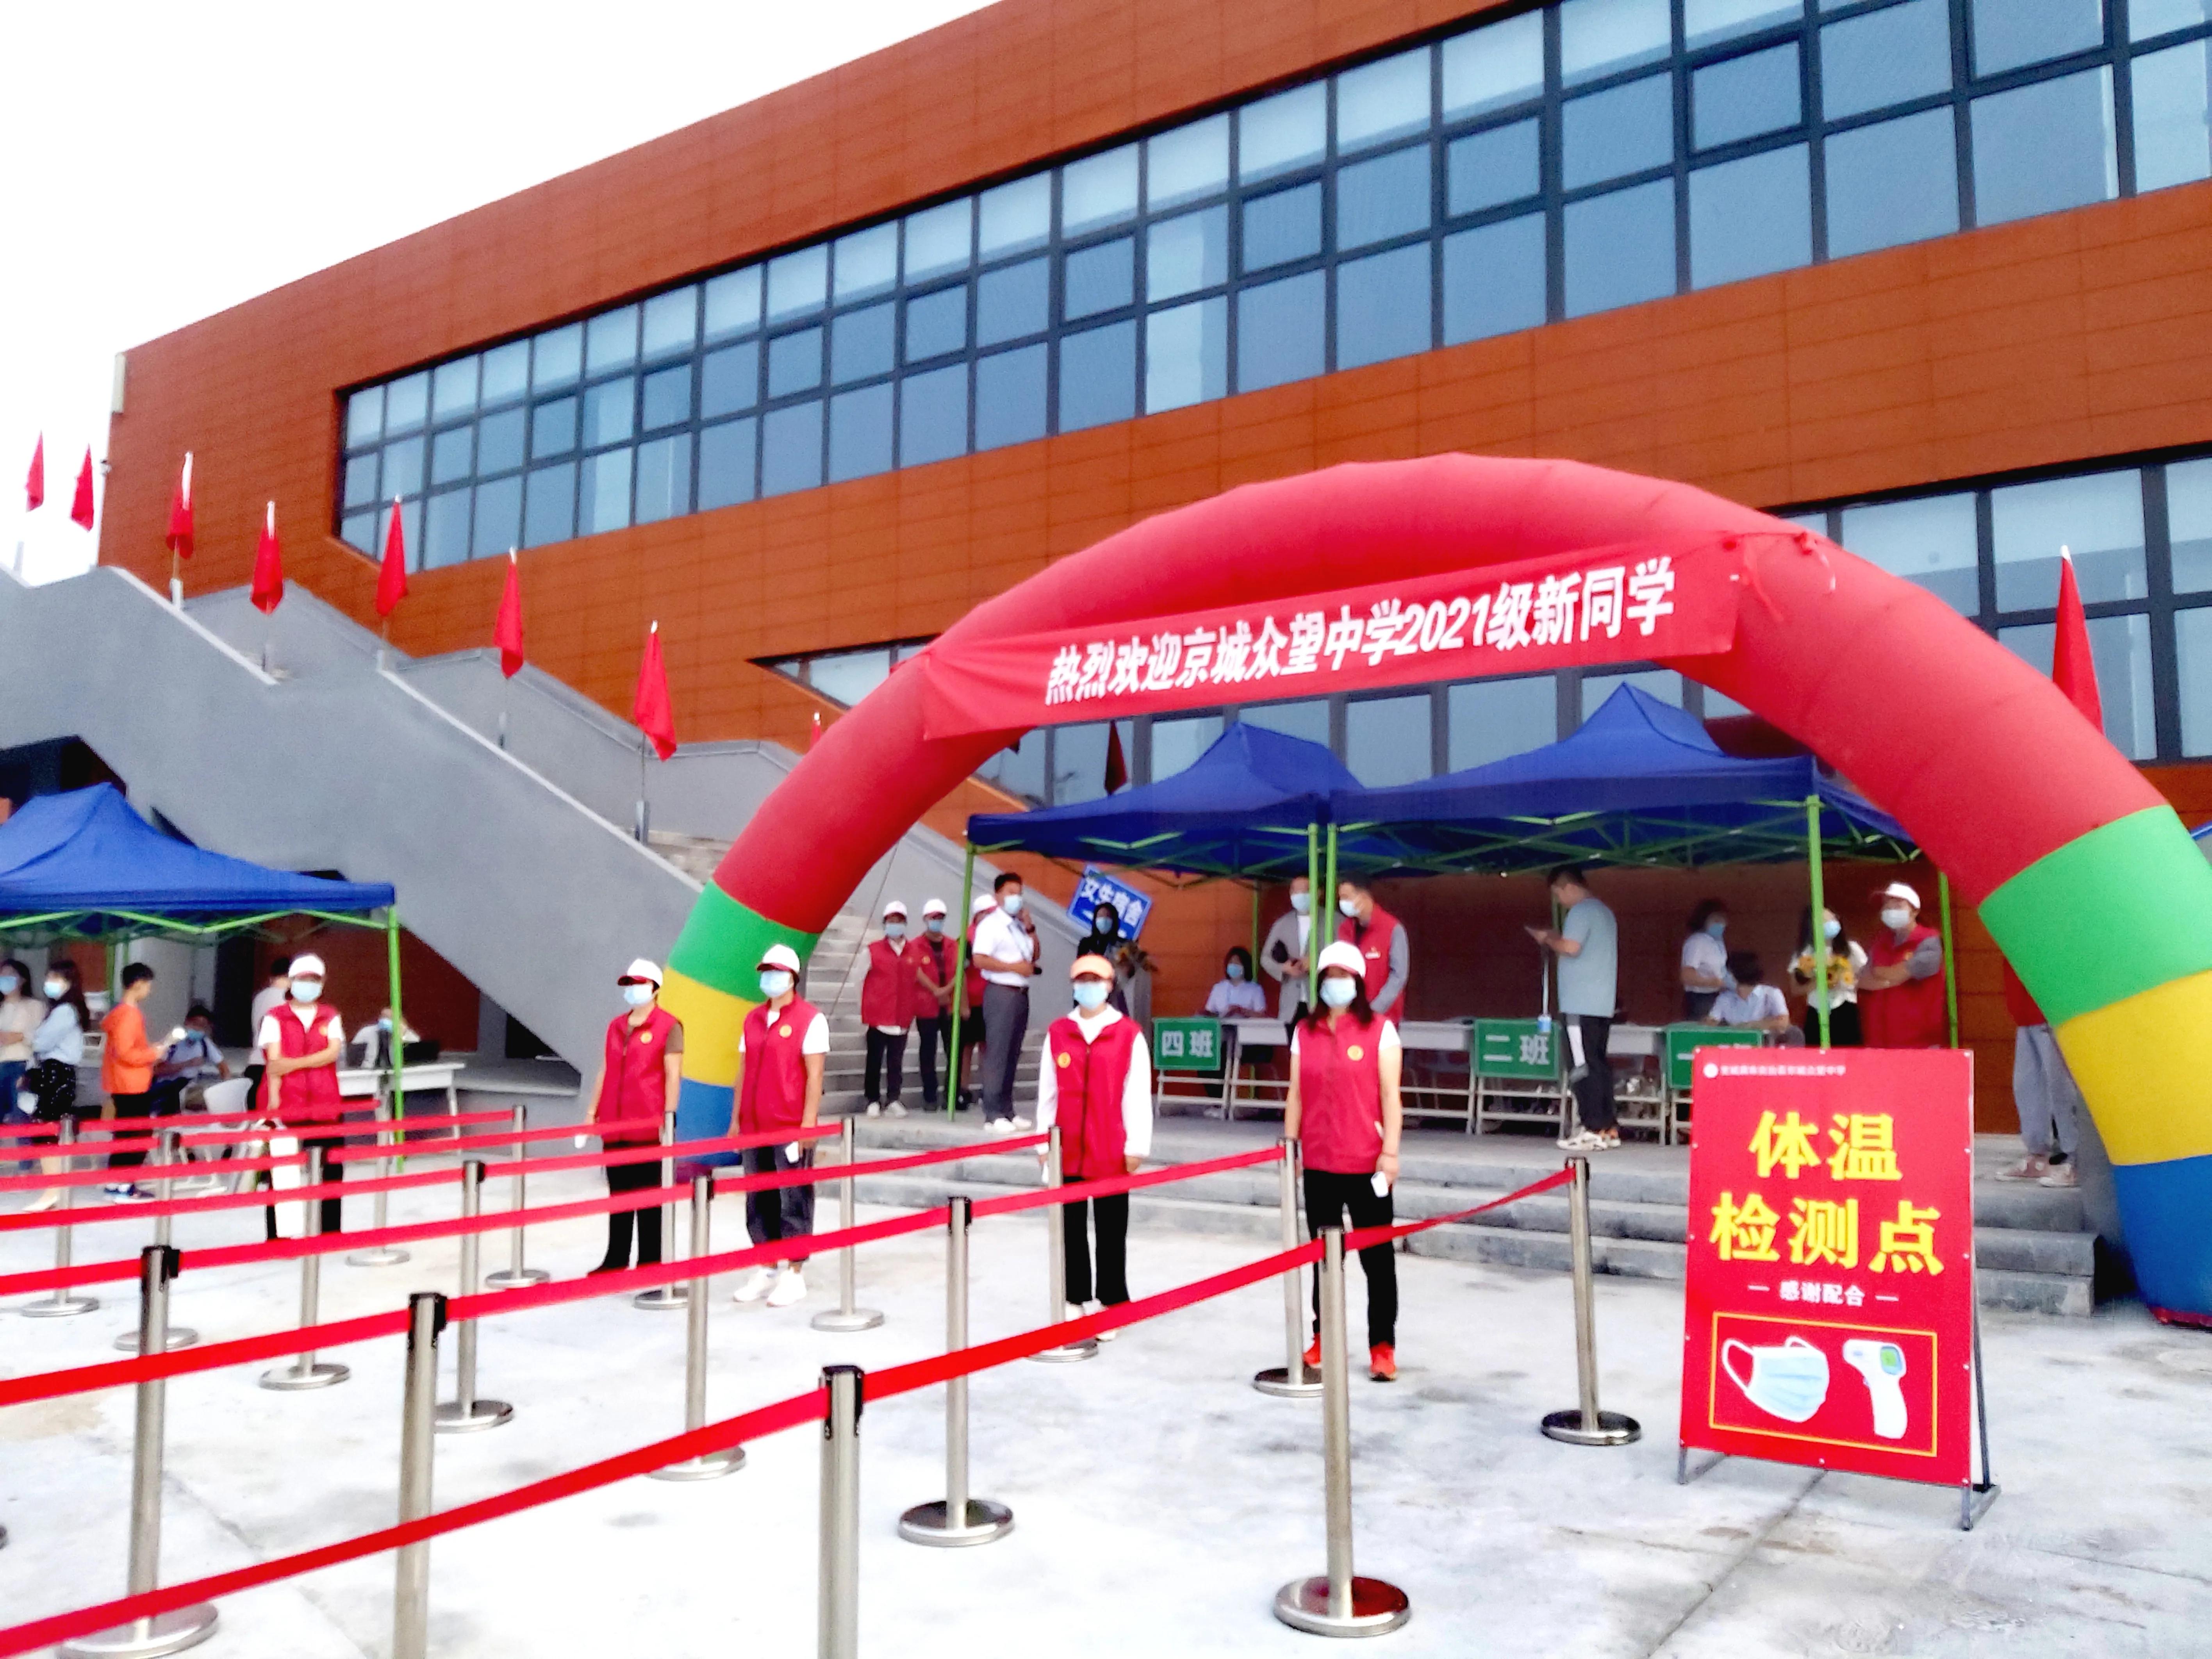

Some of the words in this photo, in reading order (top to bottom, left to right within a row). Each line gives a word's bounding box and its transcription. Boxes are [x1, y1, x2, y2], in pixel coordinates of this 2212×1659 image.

[1045, 556, 1675, 705] 热烈欢迎京城众望中学2021级新同学
[1161, 1030, 1213, 1057] 四班
[1483, 1035, 1550, 1065] 二班
[1748, 1110, 1903, 1180] 体温
[1709, 1192, 1944, 1275] 检测点
[1780, 1280, 1865, 1306] 感谢配合
